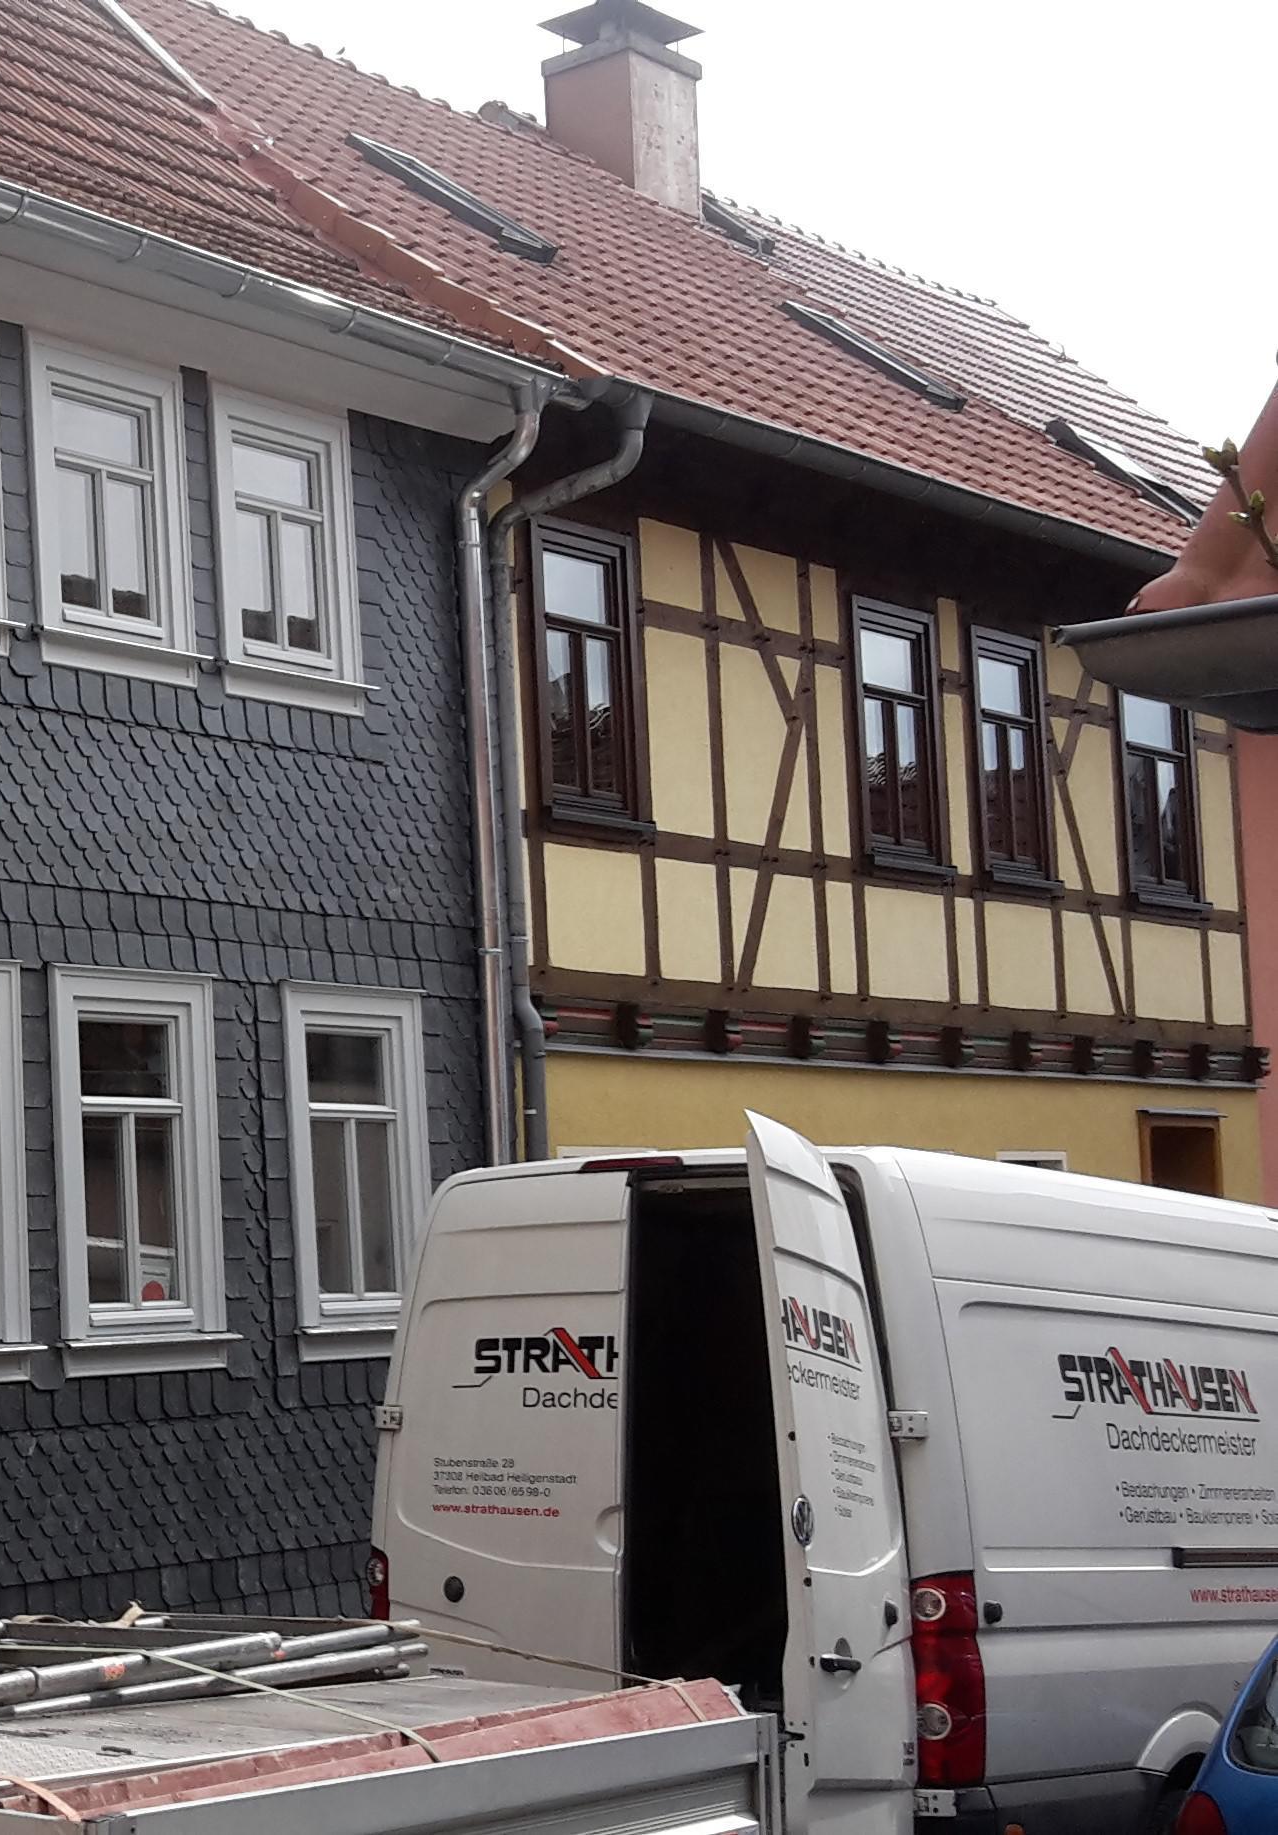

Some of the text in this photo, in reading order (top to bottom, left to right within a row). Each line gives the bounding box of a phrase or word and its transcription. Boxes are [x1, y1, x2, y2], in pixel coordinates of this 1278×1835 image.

[1057, 1346, 1258, 1414] STRATHAUSEN
[1106, 1422, 1257, 1457] Dachdeckermeister
[1122, 1481, 1189, 1502] Bedachungen
[432, 1503, 560, 1518] www.strathausen.de
